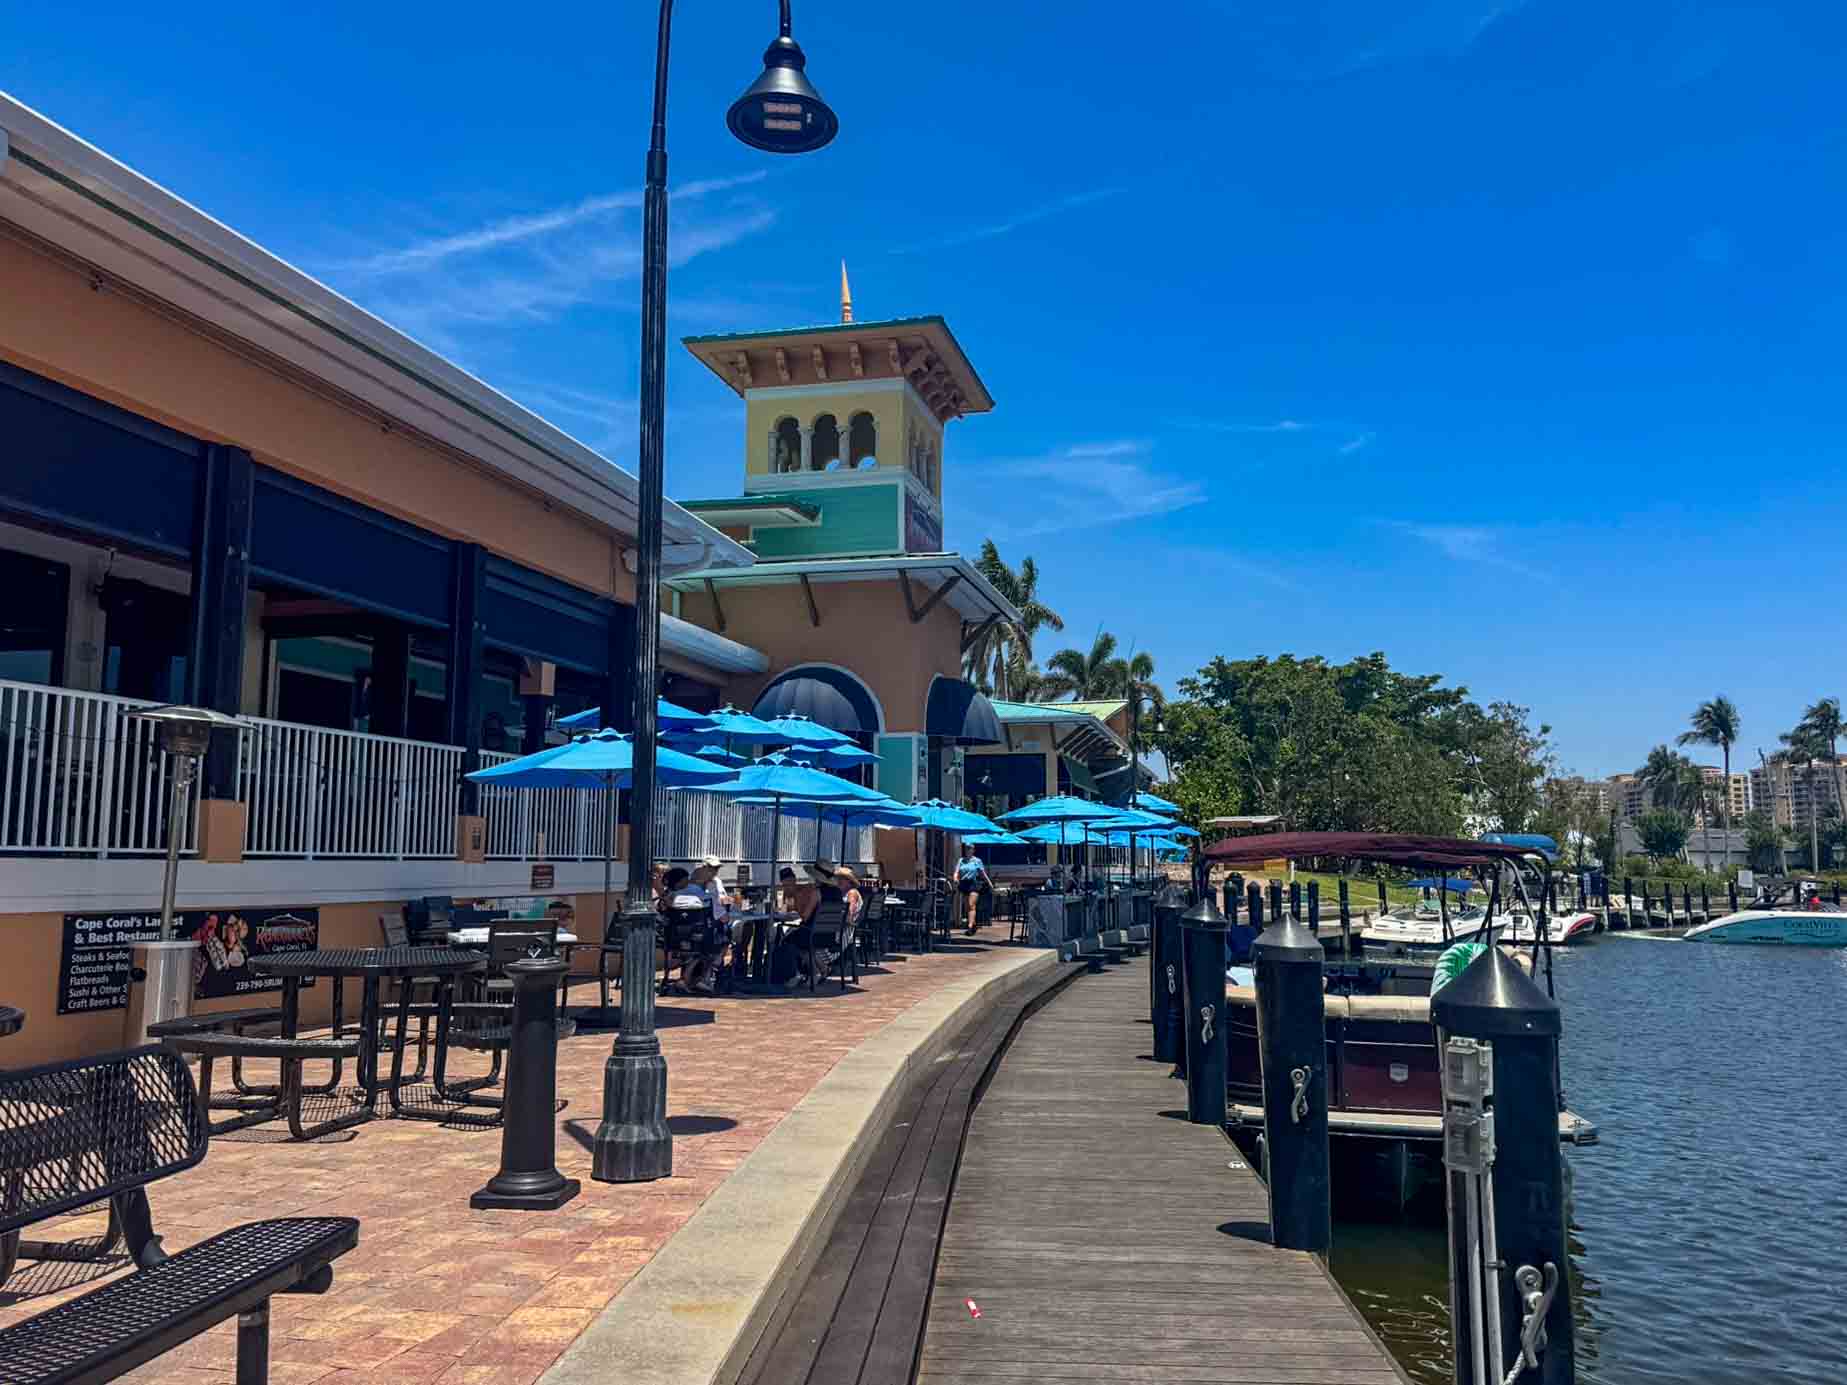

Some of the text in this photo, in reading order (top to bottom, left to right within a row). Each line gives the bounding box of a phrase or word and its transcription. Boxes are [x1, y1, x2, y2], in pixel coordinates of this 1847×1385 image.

[76, 915, 184, 931] Cape Coral's Larst
[74, 932, 84, 944] &
[88, 932, 113, 944] Best
[271, 942, 285, 953] Cape
[72, 952, 96, 963] Steaks
[98, 952, 104, 961] &
[71, 963, 113, 975] Charcuterie
[71, 974, 109, 986] Flatbreads
[69, 986, 89, 998] Sushi
[92, 986, 98, 995] &
[99, 985, 121, 995] Other
[68, 998, 88, 1009] Craft
[89, 997, 110, 1008] Beers
